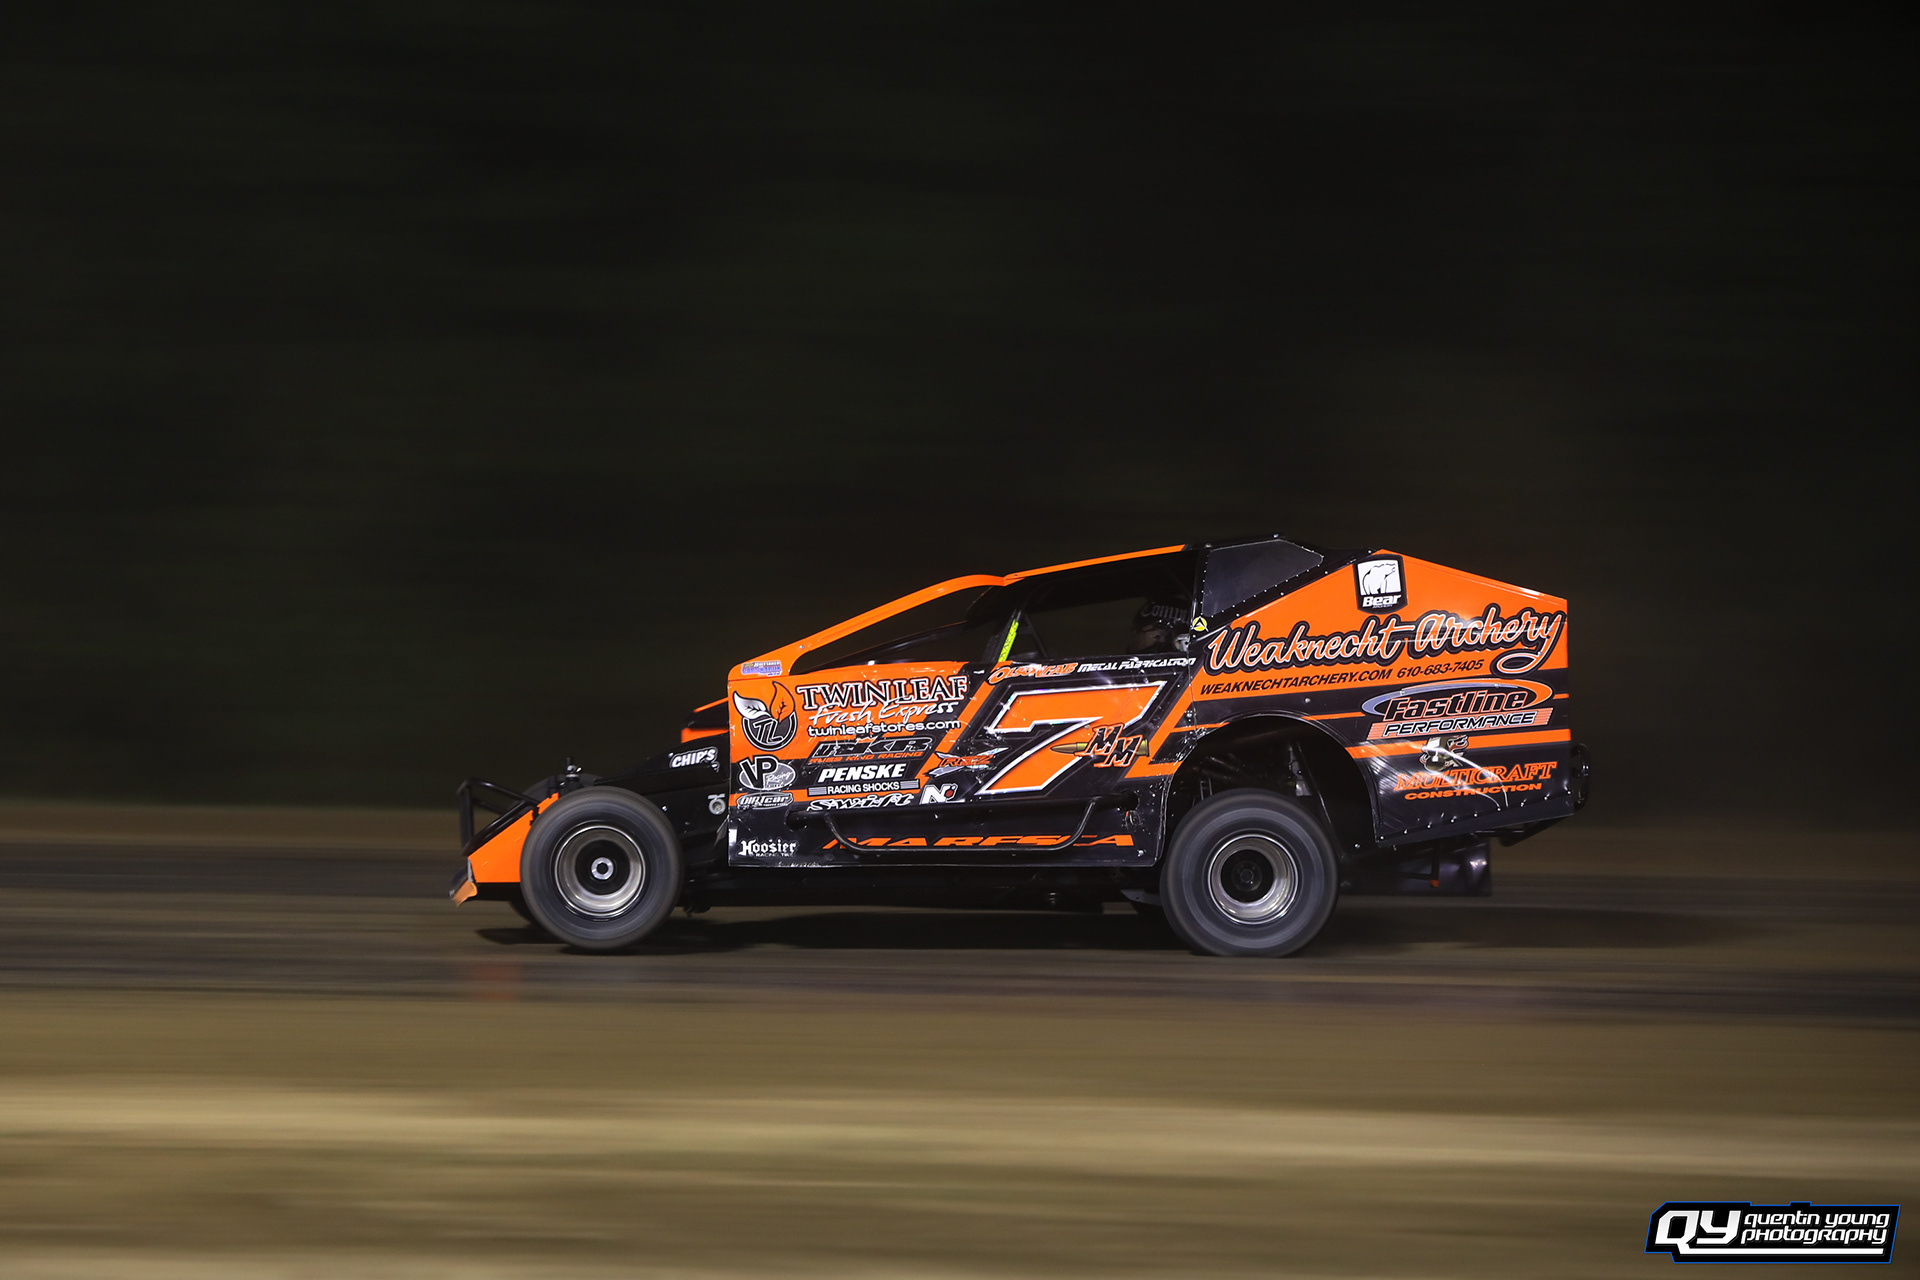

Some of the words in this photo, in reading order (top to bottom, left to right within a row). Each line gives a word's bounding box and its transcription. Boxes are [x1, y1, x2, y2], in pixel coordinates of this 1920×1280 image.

[1362, 594, 1402, 607] Bear
[1208, 617, 1415, 669] Weaknecht
[1200, 668, 1392, 696] WEAKNECHTARCHERY.COM
[1397, 658, 1485, 679] 610-683-7405
[1382, 690, 1529, 722] Fastline
[808, 719, 961, 737] twinleafstores.com
[1382, 711, 1538, 737] PERFORMANCE
[974, 680, 1168, 795] 7
[878, 751, 924, 760] RACING
[739, 753, 778, 790] VP
[817, 763, 907, 783] PENSKE
[1394, 761, 1558, 791] MULTICRAFT
[827, 785, 861, 795] RACING
[862, 781, 900, 792] SHOCKS
[1404, 782, 1542, 800] CONSTRUCTION
[738, 839, 797, 856] Hoosier
